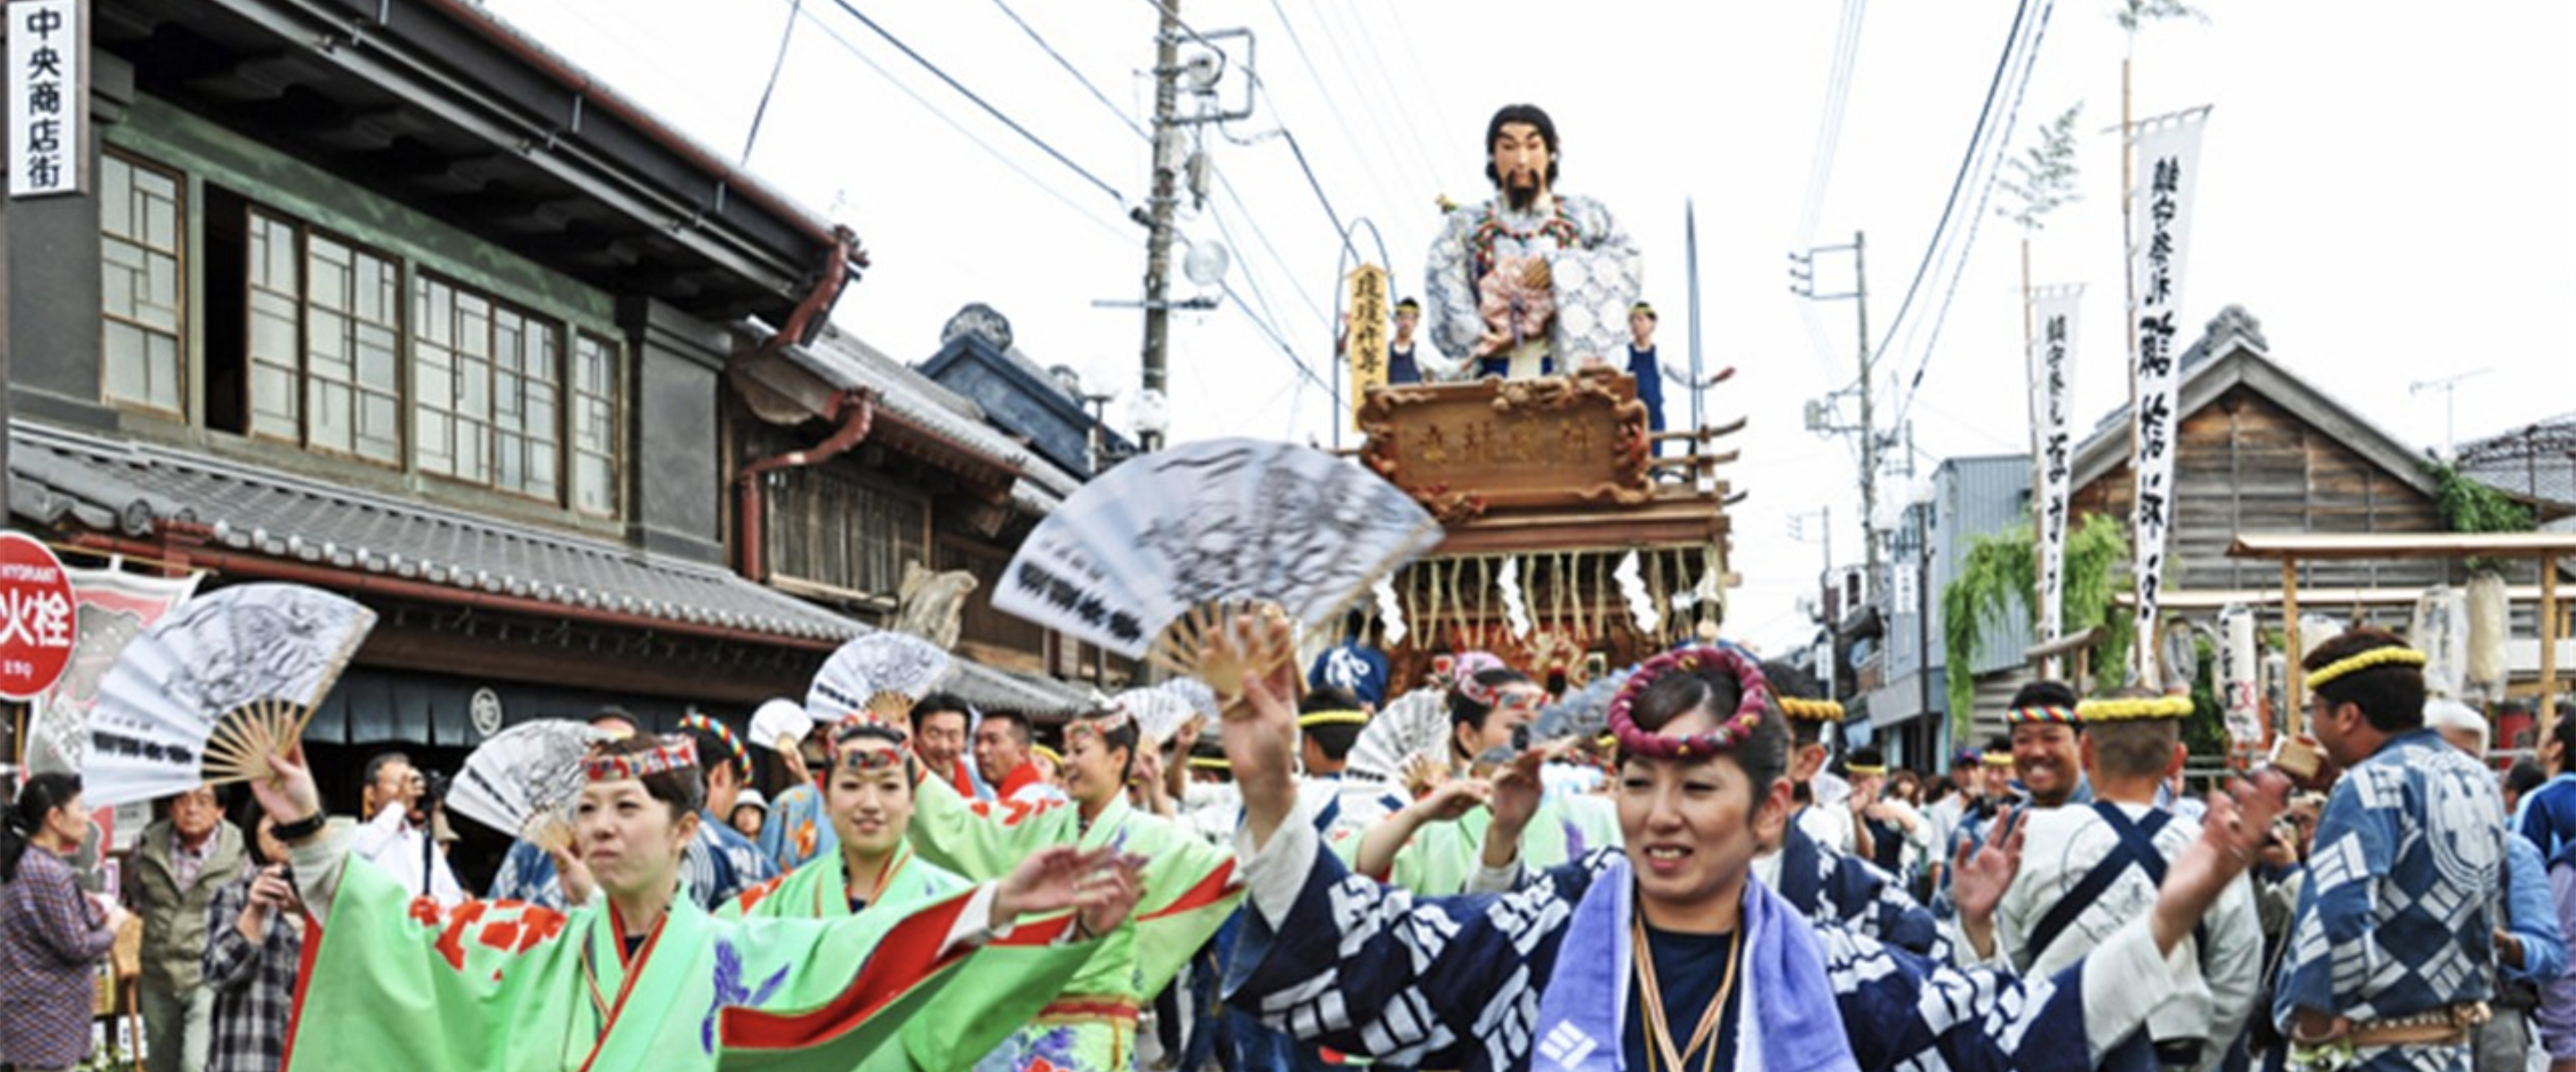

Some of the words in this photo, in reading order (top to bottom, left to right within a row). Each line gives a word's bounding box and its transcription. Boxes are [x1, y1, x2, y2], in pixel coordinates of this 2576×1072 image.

[26, 7, 61, 189] 中央商店街
